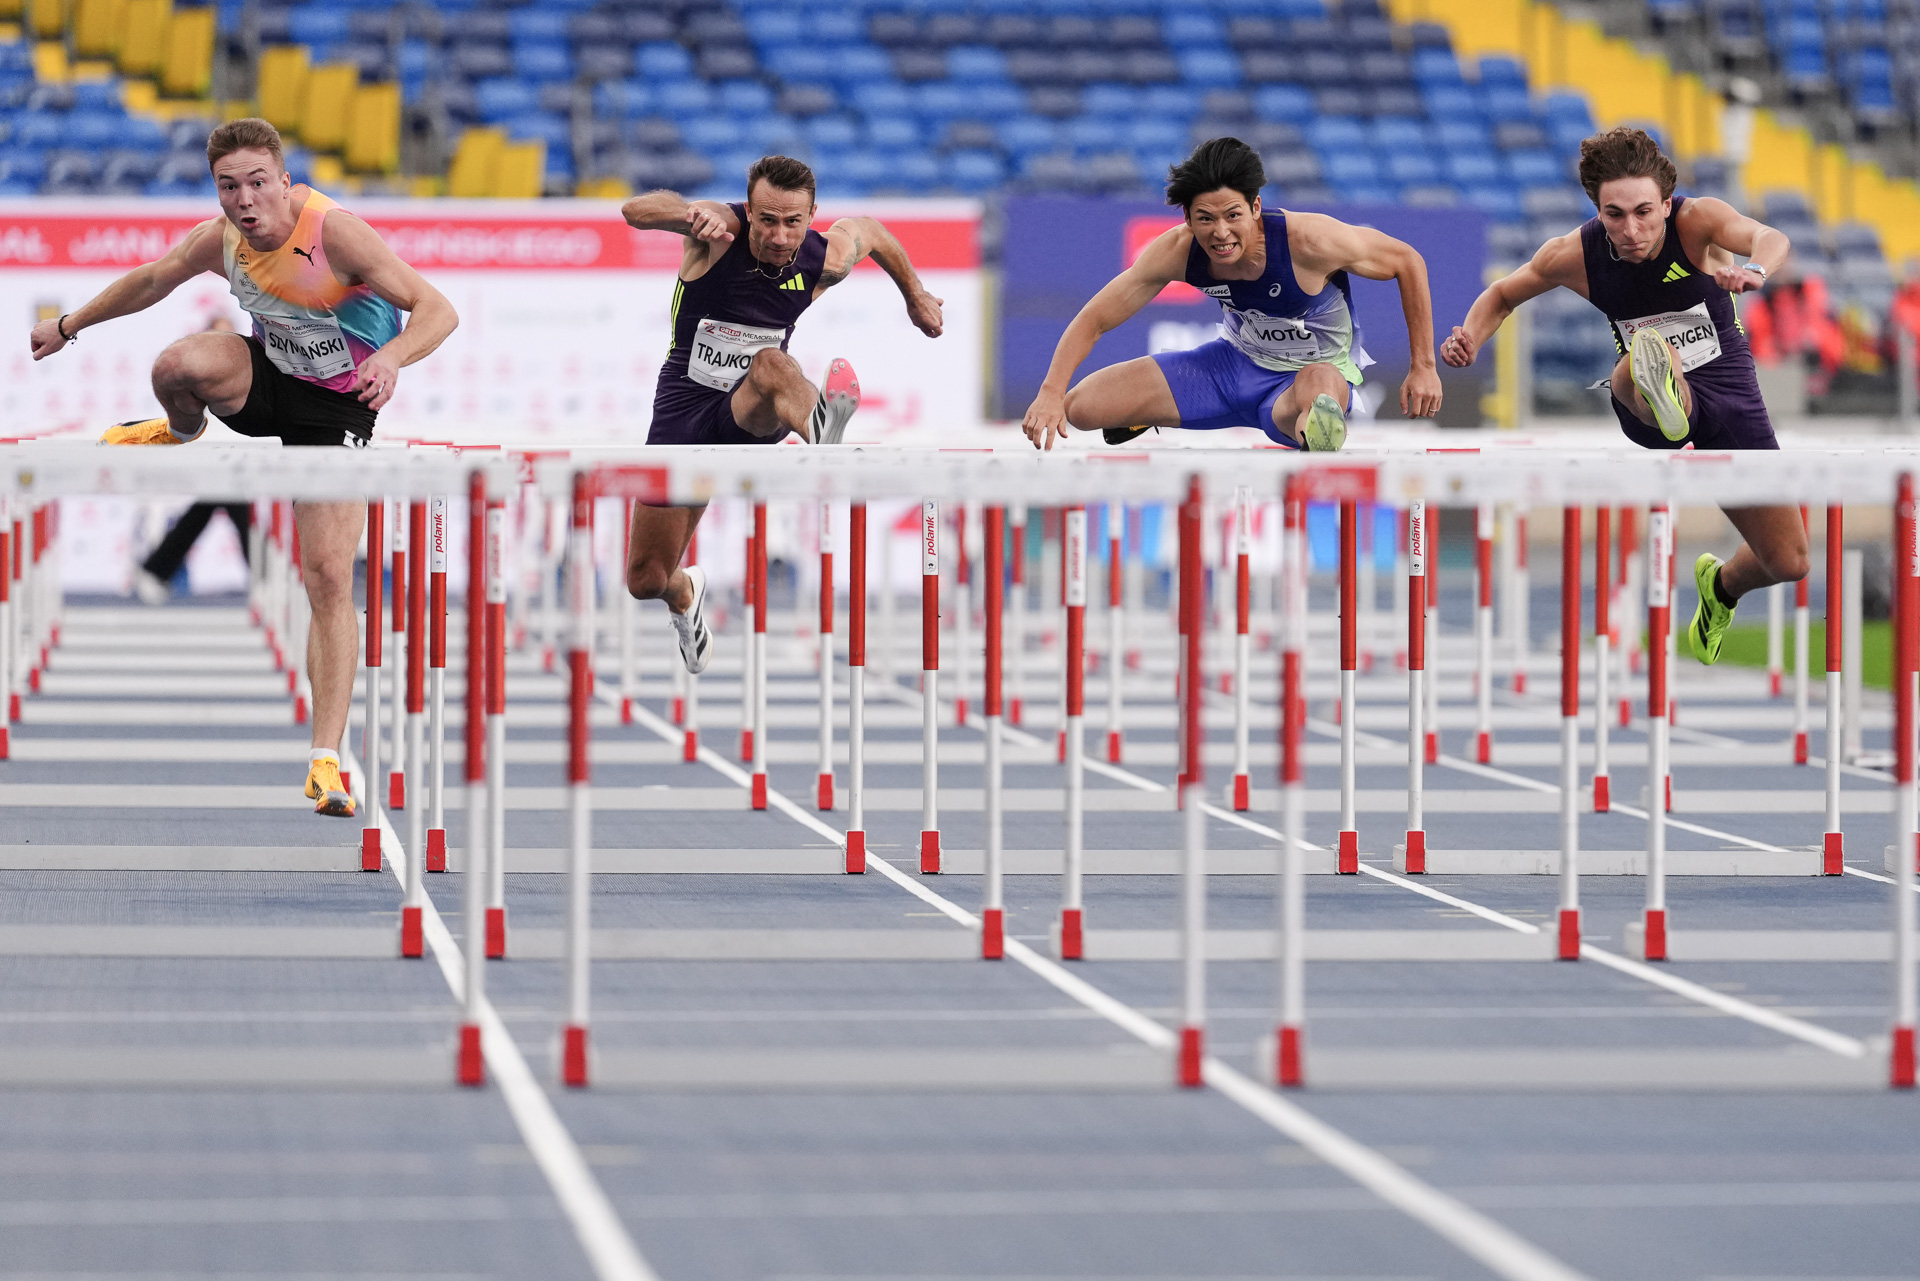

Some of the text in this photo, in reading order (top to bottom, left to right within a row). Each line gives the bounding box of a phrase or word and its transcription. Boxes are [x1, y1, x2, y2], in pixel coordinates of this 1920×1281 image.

[268, 331, 345, 361] SZYMAŃSKI
[719, 326, 741, 337] ORLEN
[697, 342, 752, 370] TRAJKO
[433, 512, 445, 554] polanik
[926, 515, 937, 556] polanik
[1411, 515, 1422, 556] polanik
